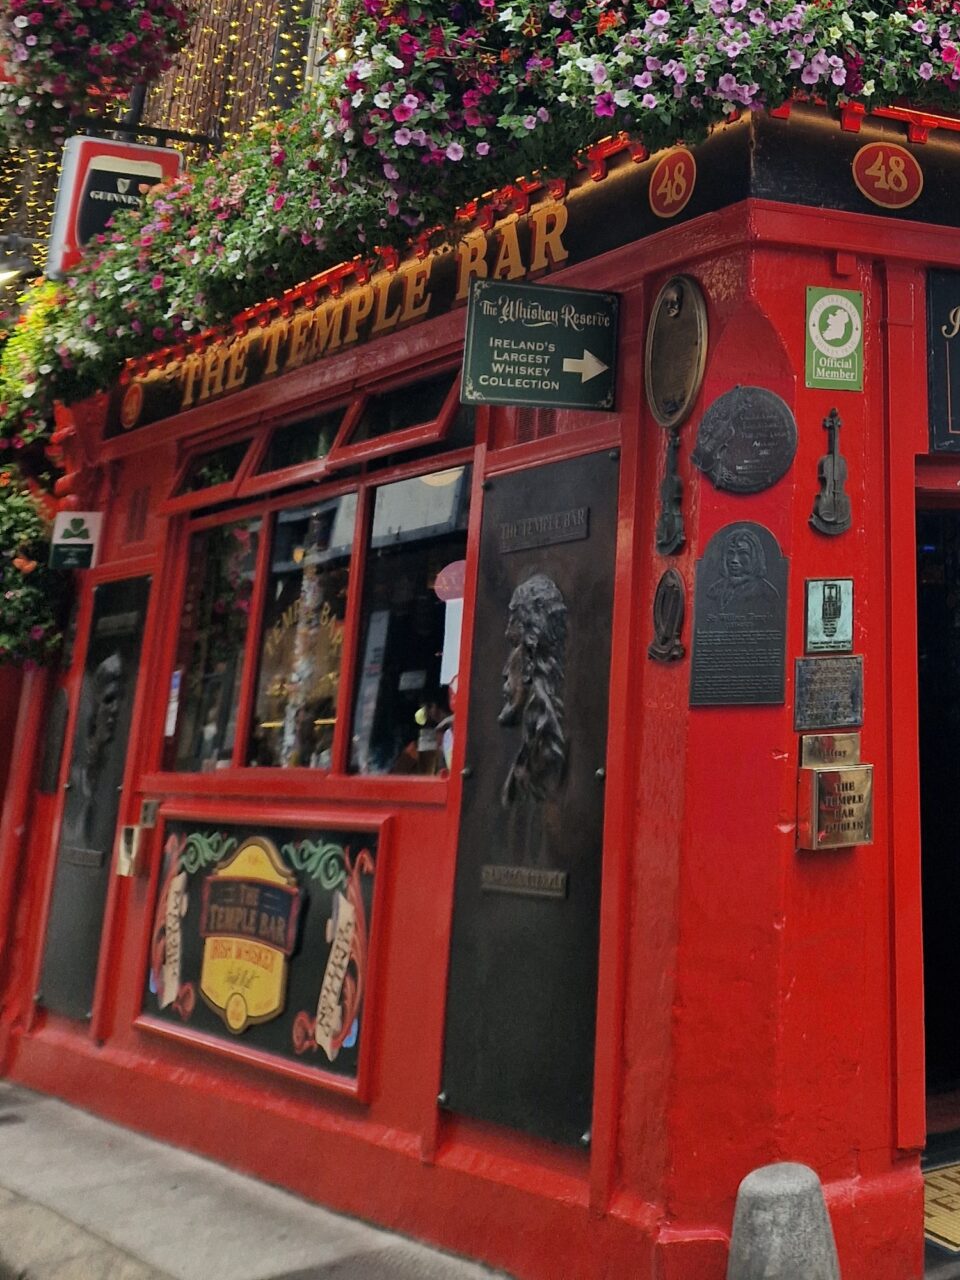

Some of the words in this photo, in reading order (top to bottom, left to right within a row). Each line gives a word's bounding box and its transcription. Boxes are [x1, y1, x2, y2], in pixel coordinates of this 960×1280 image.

[864, 151, 908, 192] 48
[656, 162, 687, 207] 48
[180, 344, 251, 407] THE
[262, 258, 434, 374] TEMPLE
[456, 202, 569, 300] BAR
[479, 299, 498, 317] The
[498, 295, 559, 328] Whiskey
[560, 303, 610, 331] Reserve
[489, 336, 556, 352] IRELAND'S
[493, 350, 550, 364] LARGEST
[819, 357, 852, 369] Official
[491, 363, 551, 377] WHISKEY
[816, 367, 855, 379] Member
[479, 374, 560, 390] COLLECTION
[834, 781, 855, 792] THE
[825, 793, 864, 807] TEMPLE
[834, 808, 855, 819] BAR
